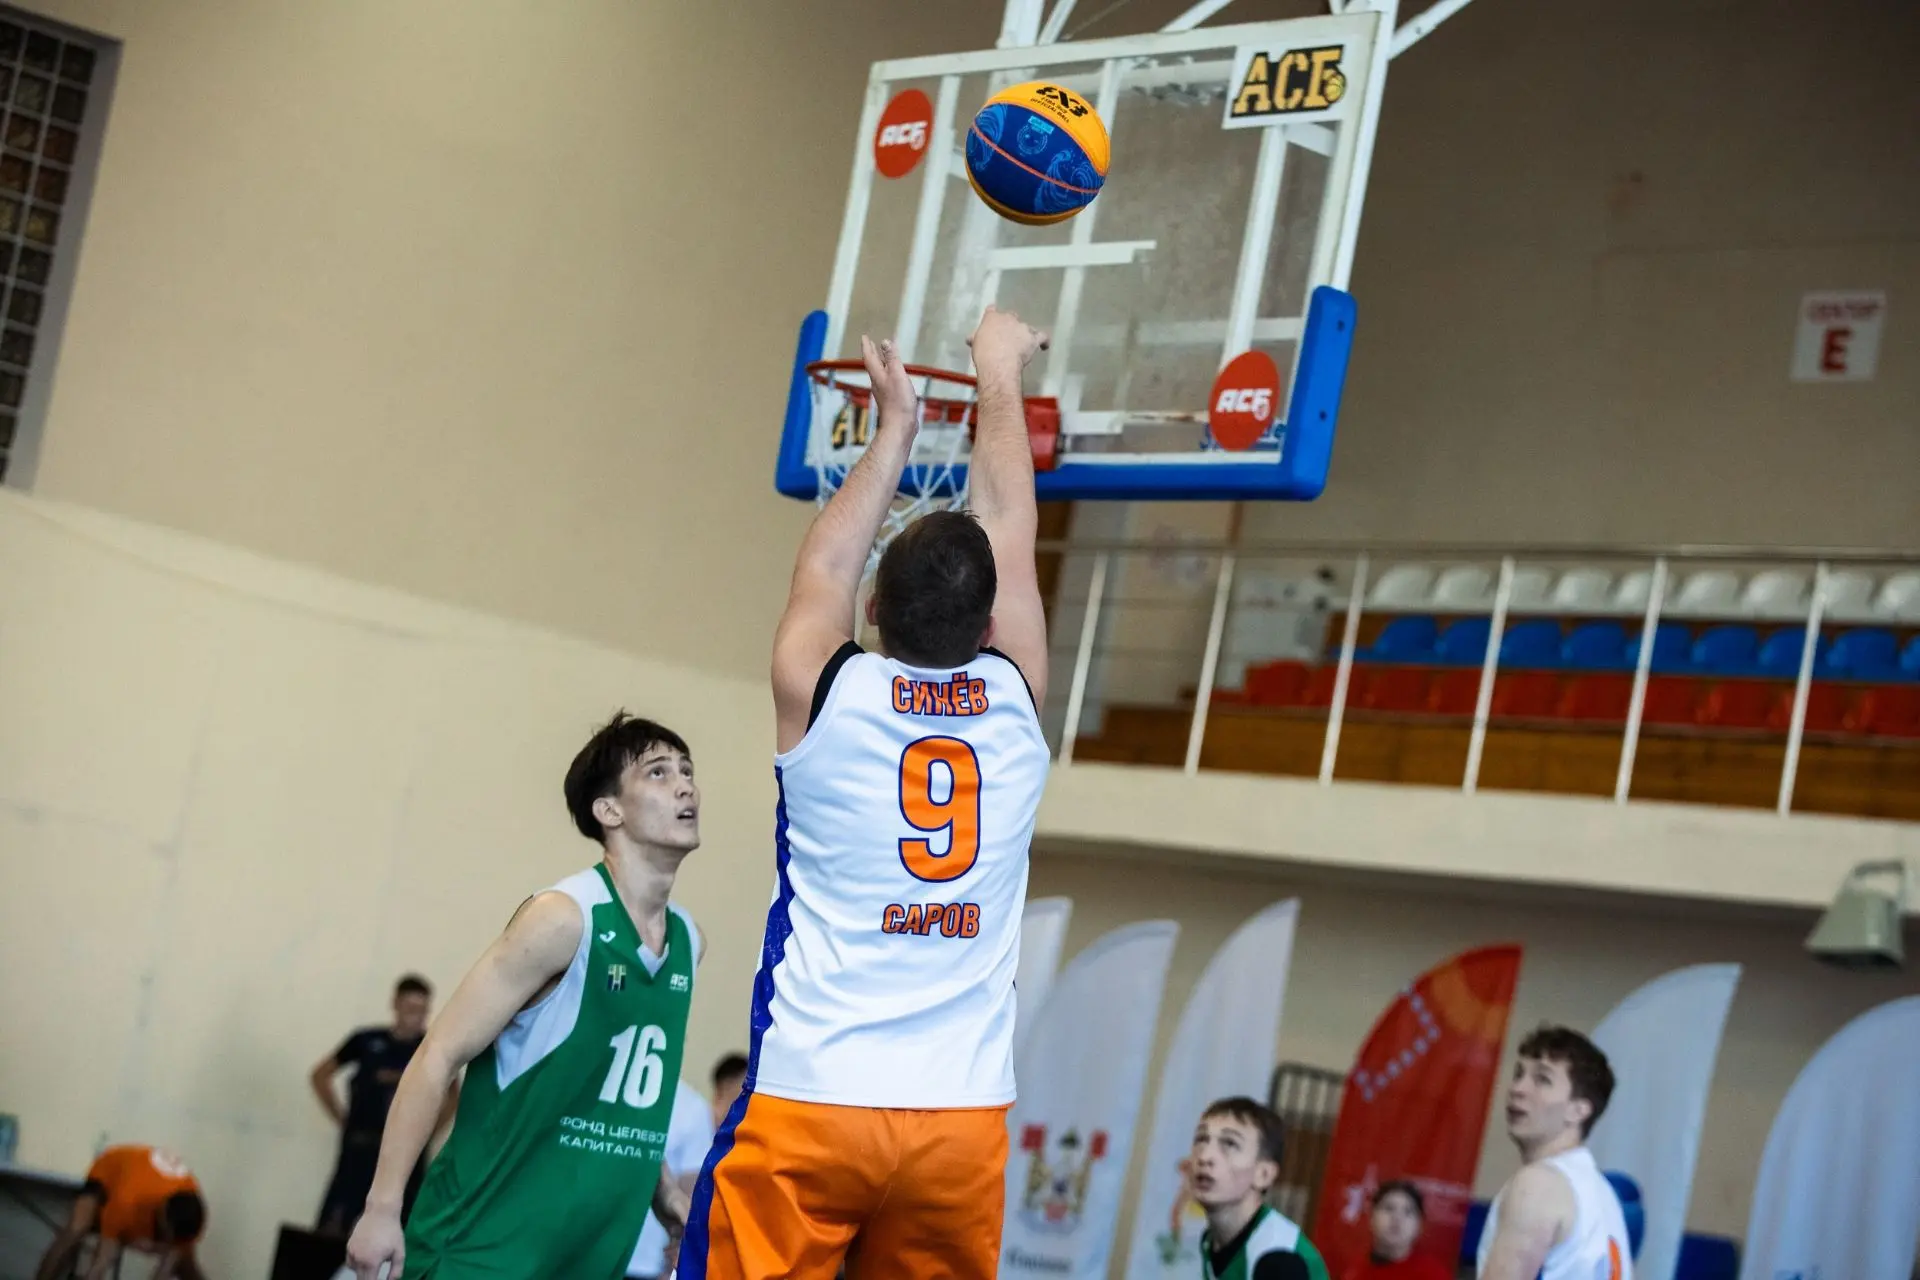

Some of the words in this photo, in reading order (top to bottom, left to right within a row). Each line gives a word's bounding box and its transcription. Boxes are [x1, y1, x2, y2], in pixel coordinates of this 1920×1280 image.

[892, 671, 989, 716] СИНЁВ
[898, 735, 982, 883] 9
[882, 903, 980, 939] САРОВ
[599, 1025, 667, 1109] 16
[560, 1116, 606, 1136] ФОНД
[560, 1134, 642, 1158] КАПИТАЛА
